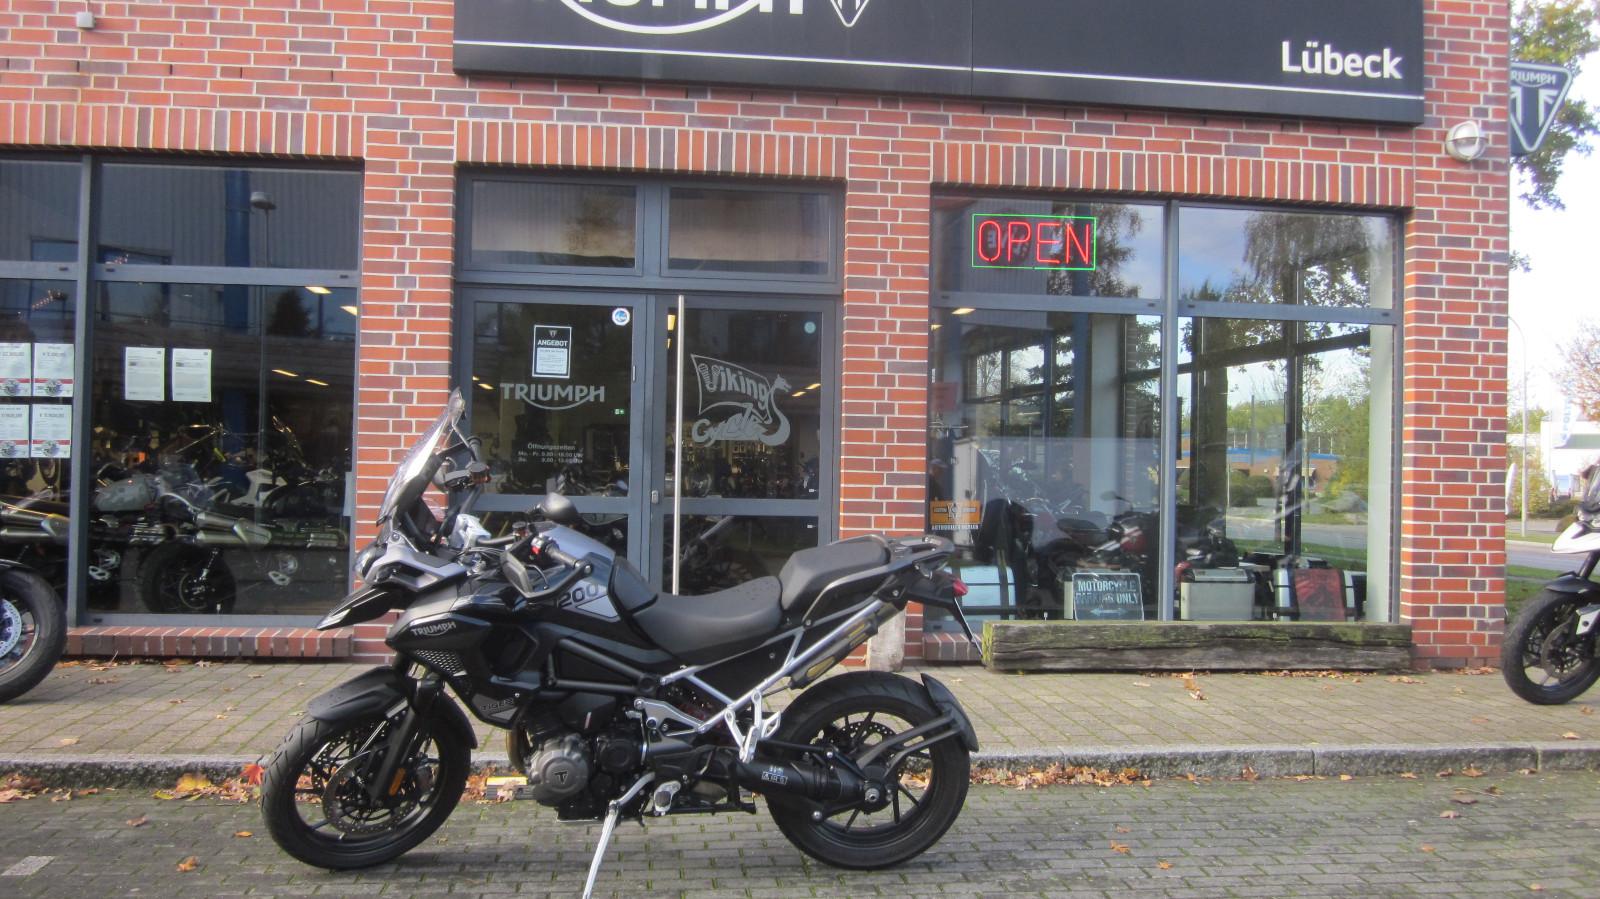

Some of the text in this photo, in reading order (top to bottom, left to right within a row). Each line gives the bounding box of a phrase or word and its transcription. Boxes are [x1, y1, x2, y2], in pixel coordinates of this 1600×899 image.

[1281, 40, 1403, 80] Lübeck
[1510, 70, 1557, 86] RIUMPH
[977, 220, 1091, 265] OPEN
[537, 339, 569, 348] ANGEBOT
[697, 362, 770, 411] Viking
[499, 383, 606, 408] TRIUMPH
[1077, 580, 1137, 592] MOTORCYCLE
[1116, 592, 1139, 604] ONLY
[410, 621, 457, 636] TRIUMPH
